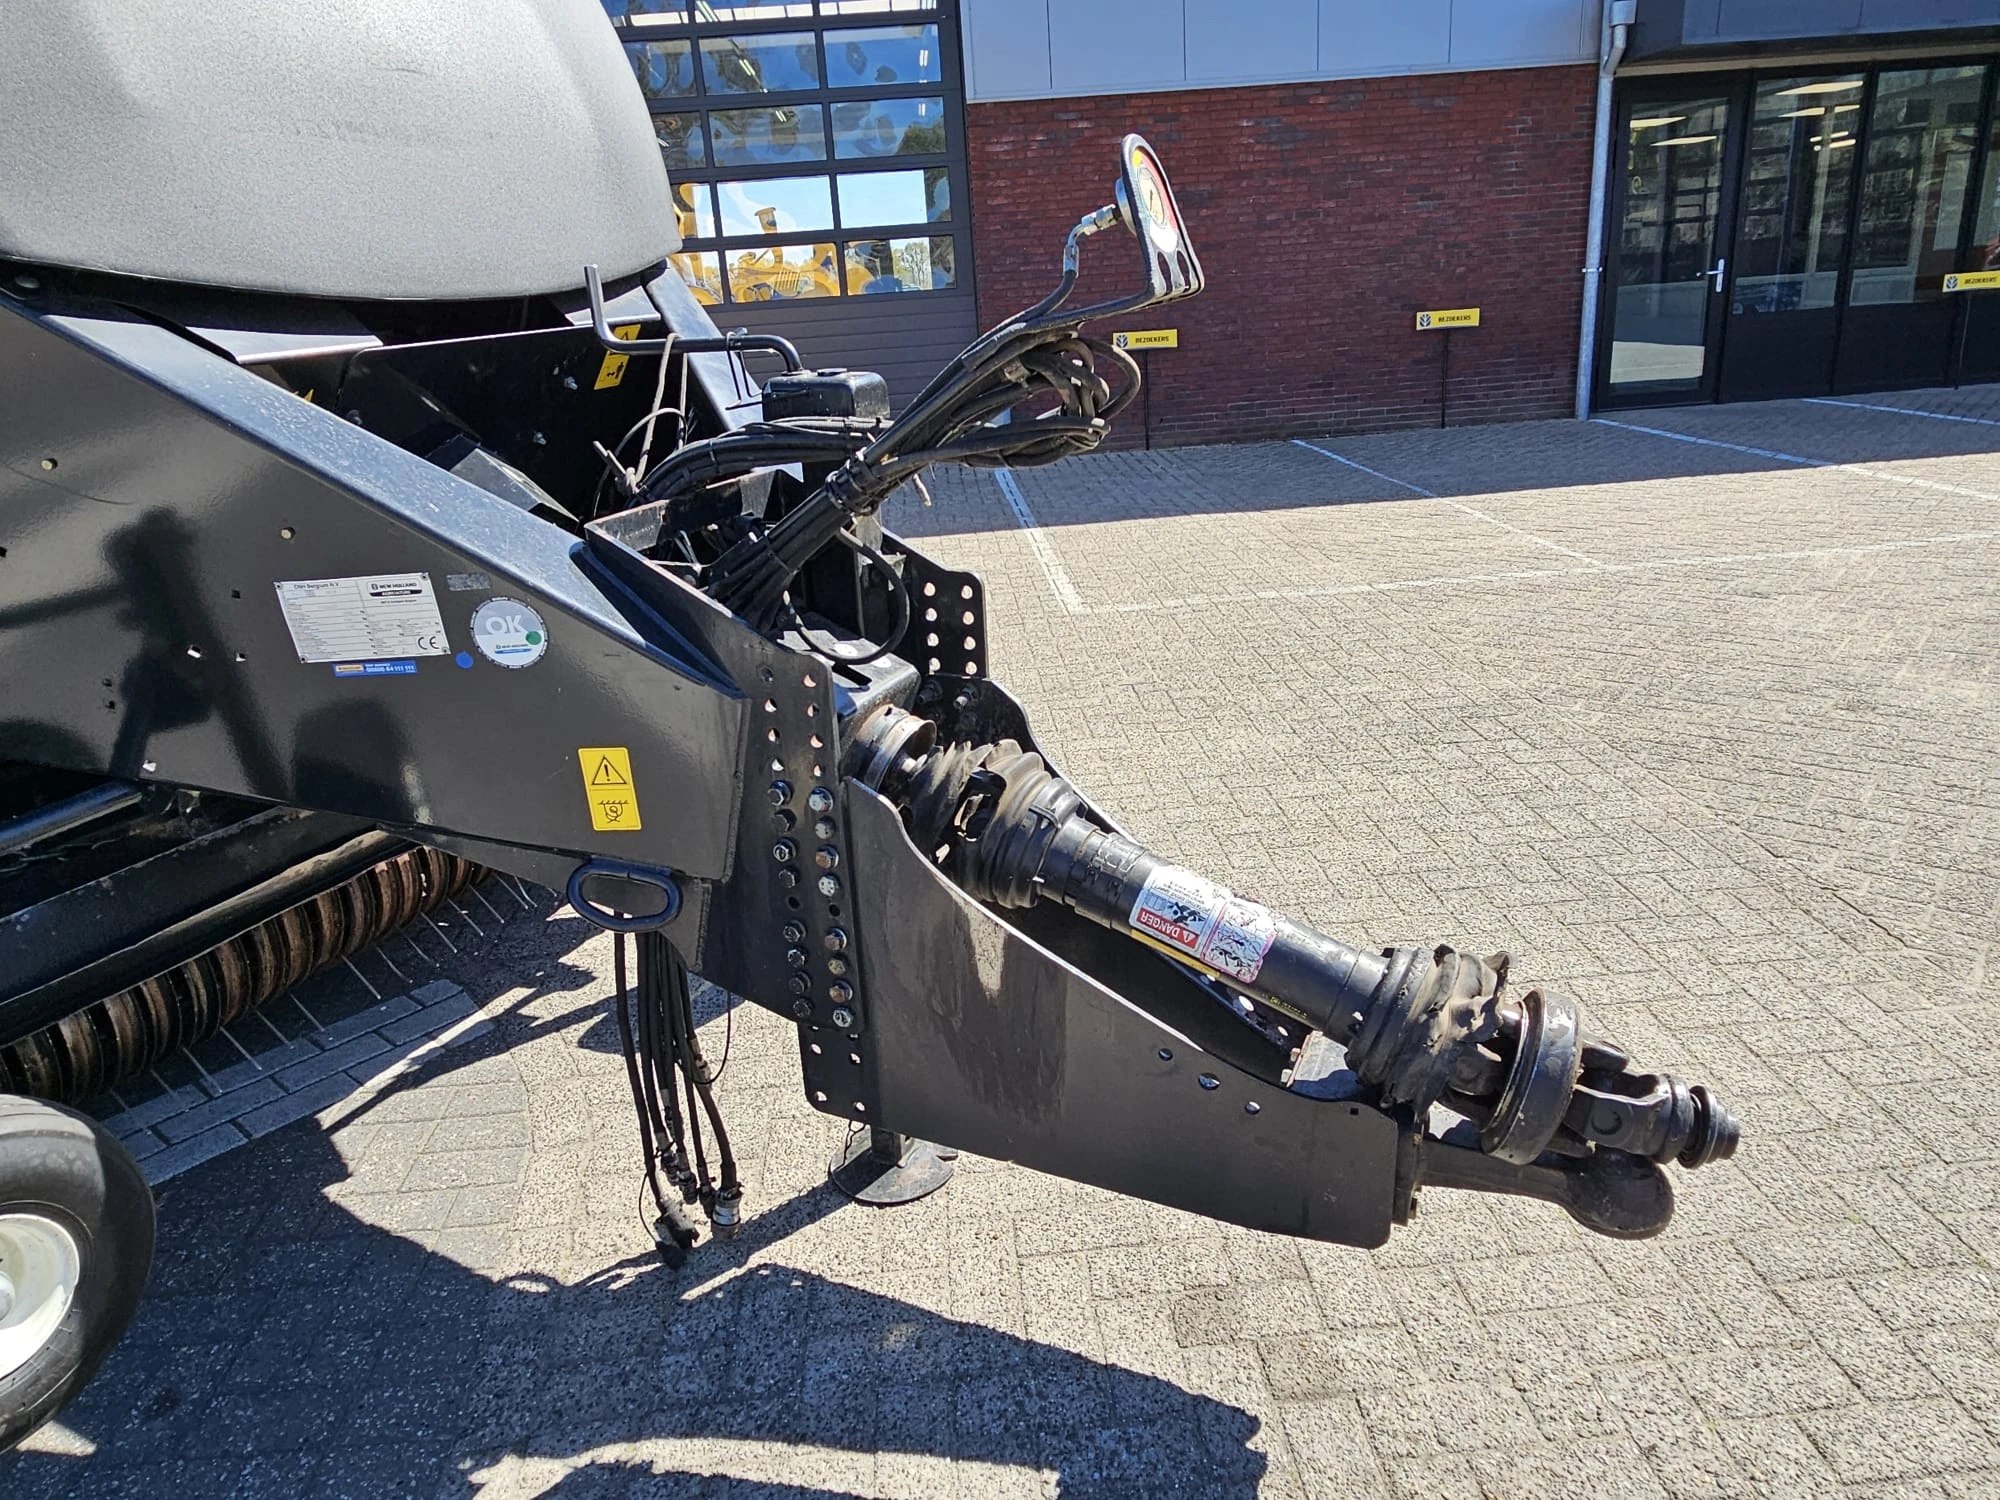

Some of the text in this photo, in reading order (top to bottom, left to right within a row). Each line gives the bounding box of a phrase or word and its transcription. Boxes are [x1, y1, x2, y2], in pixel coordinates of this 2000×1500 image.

[1438, 315, 1471, 323] BEZOEKERS
[1135, 335, 1169, 343] BEZOEKERS
[486, 615, 528, 634] OK
[418, 636, 440, 650] CE
[1140, 911, 1180, 938] DANGER
